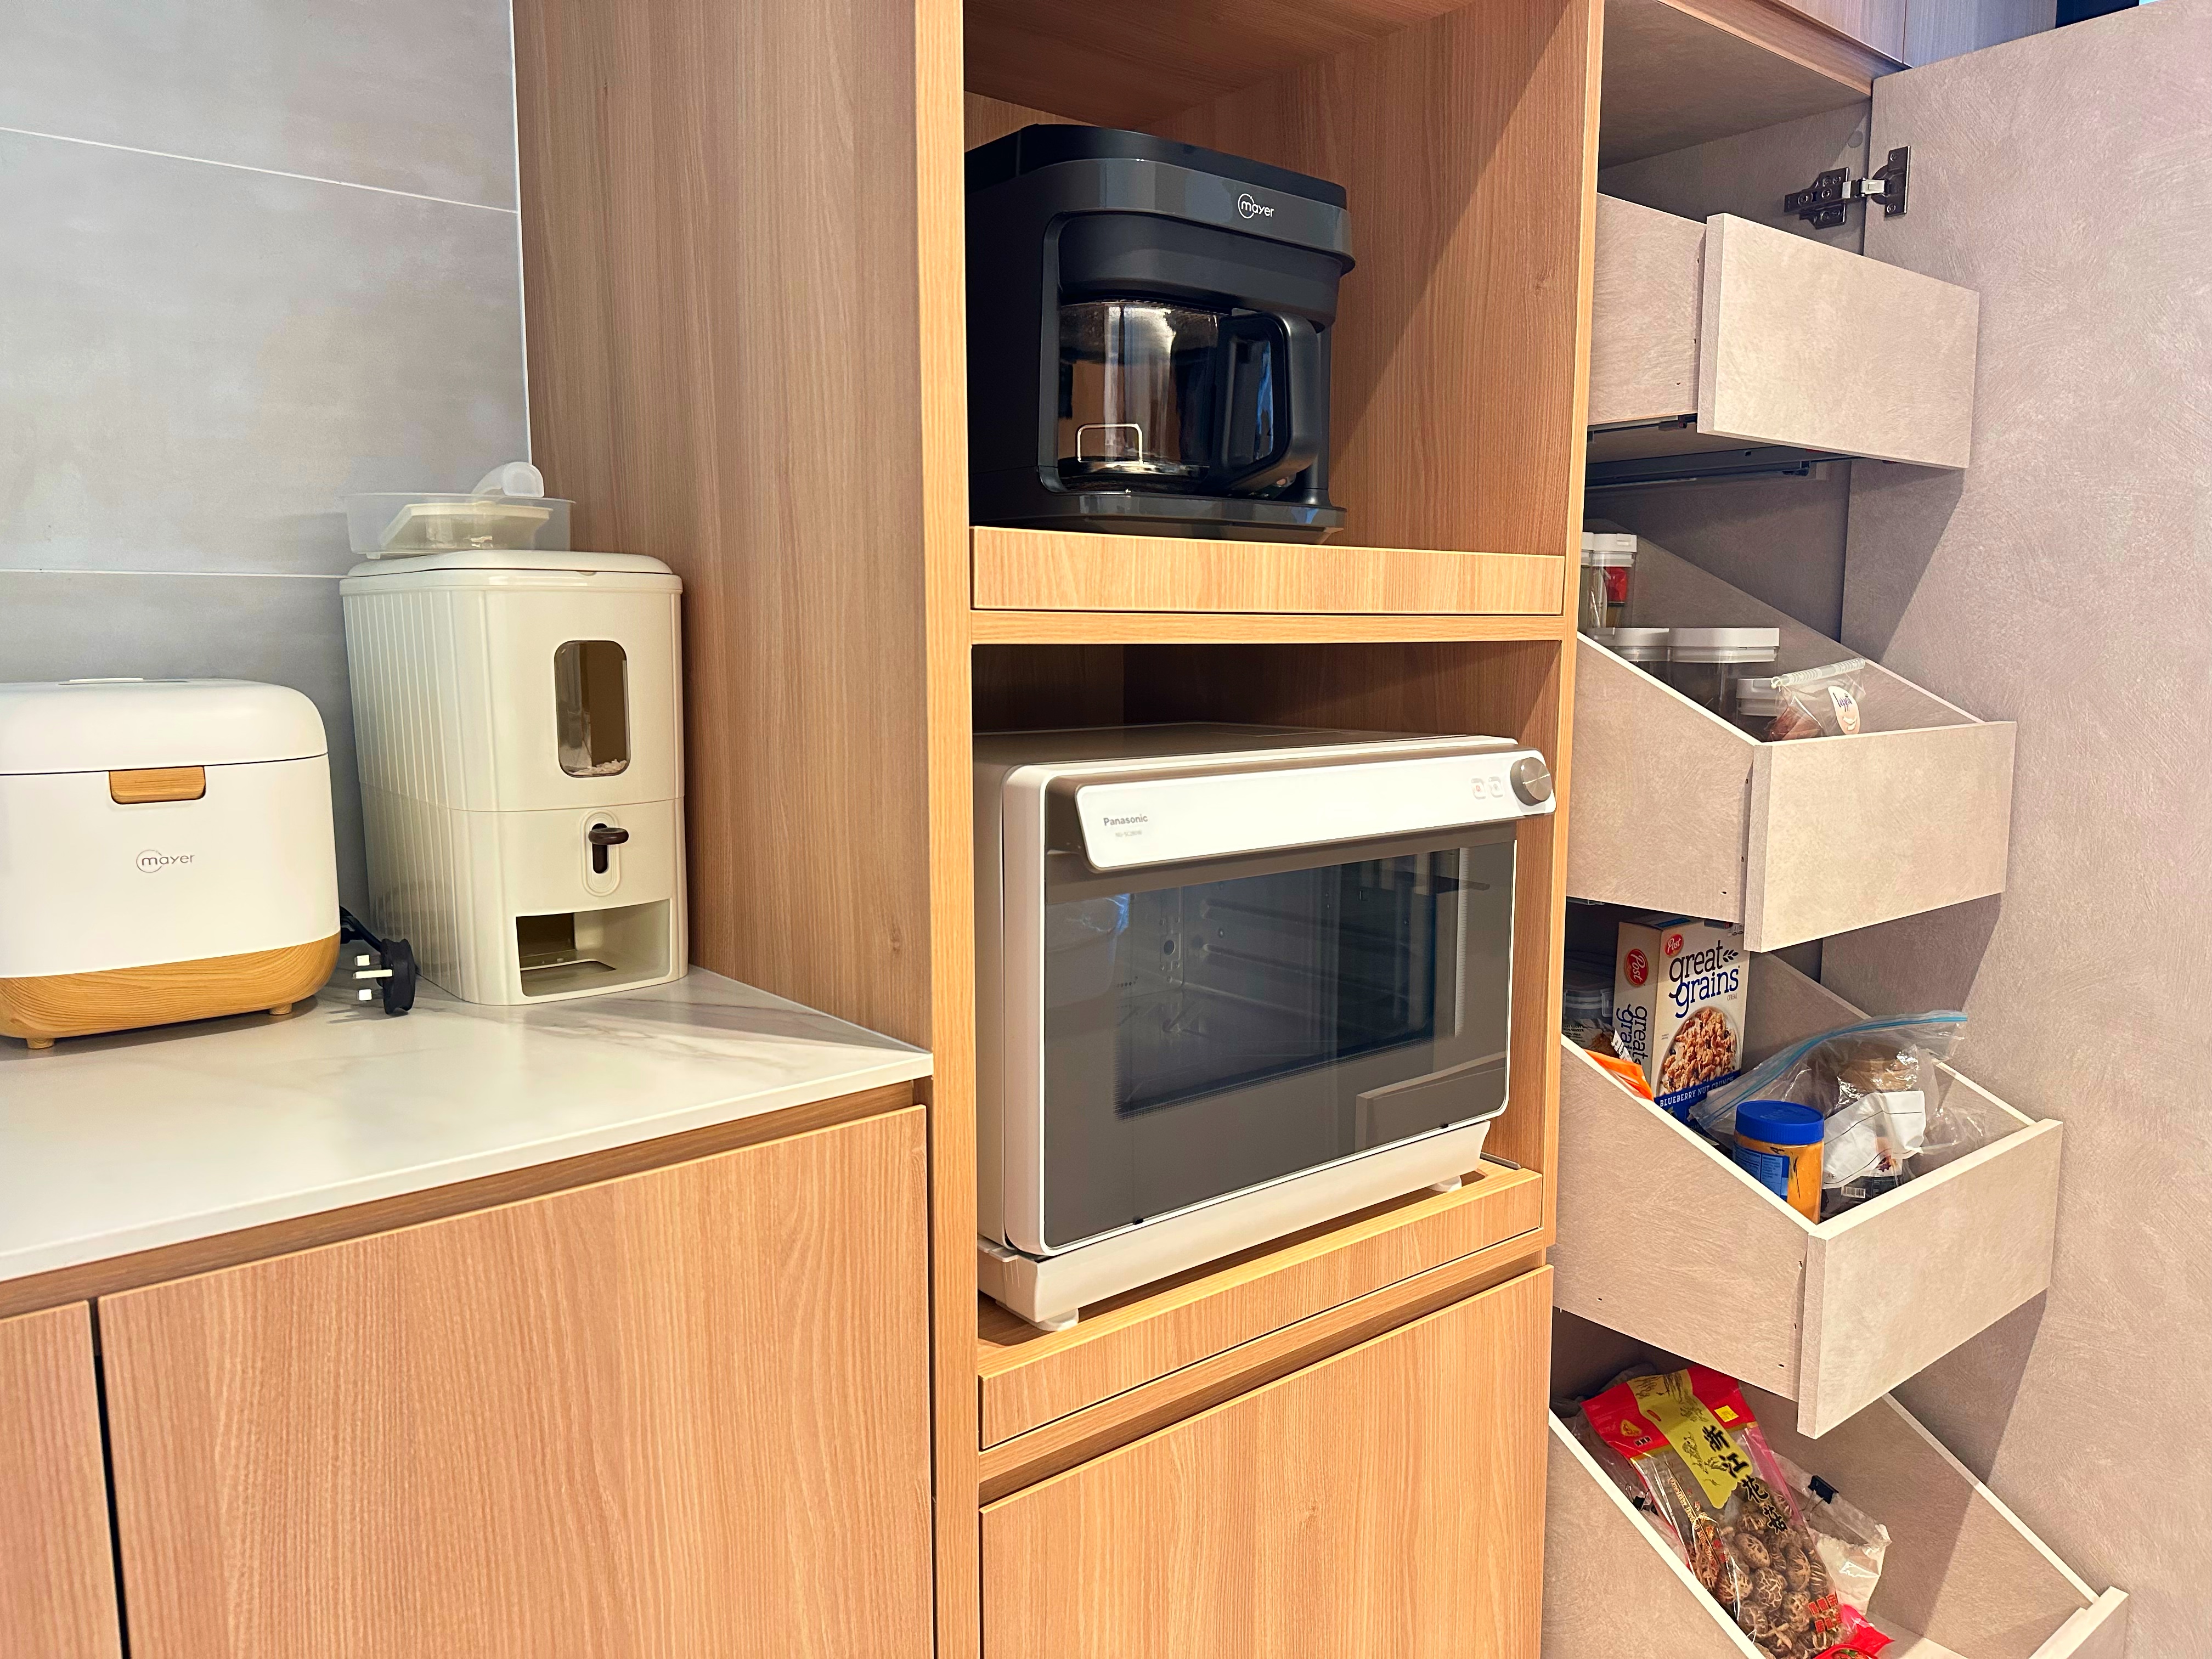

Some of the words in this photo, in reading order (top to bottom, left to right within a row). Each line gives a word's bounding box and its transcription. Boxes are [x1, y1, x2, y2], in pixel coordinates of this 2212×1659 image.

[1240, 199, 1274, 218] mayer
[1103, 814, 1148, 826] Panasonic
[140, 854, 195, 868] mayer
[1667, 937, 1681, 953] Post
[1630, 951, 1645, 983] Post
[1668, 940, 1723, 998] great
[1675, 968, 1739, 1018] grains
[1616, 1007, 1633, 1054] grai
[1627, 1003, 1649, 1059] great
[1660, 1089, 1696, 1108] BLUEBERRY
[1697, 1085, 1710, 1096] NUT
[1668, 1477, 1688, 1506] Quality
[1702, 1424, 1788, 1534] 浙江花菇
